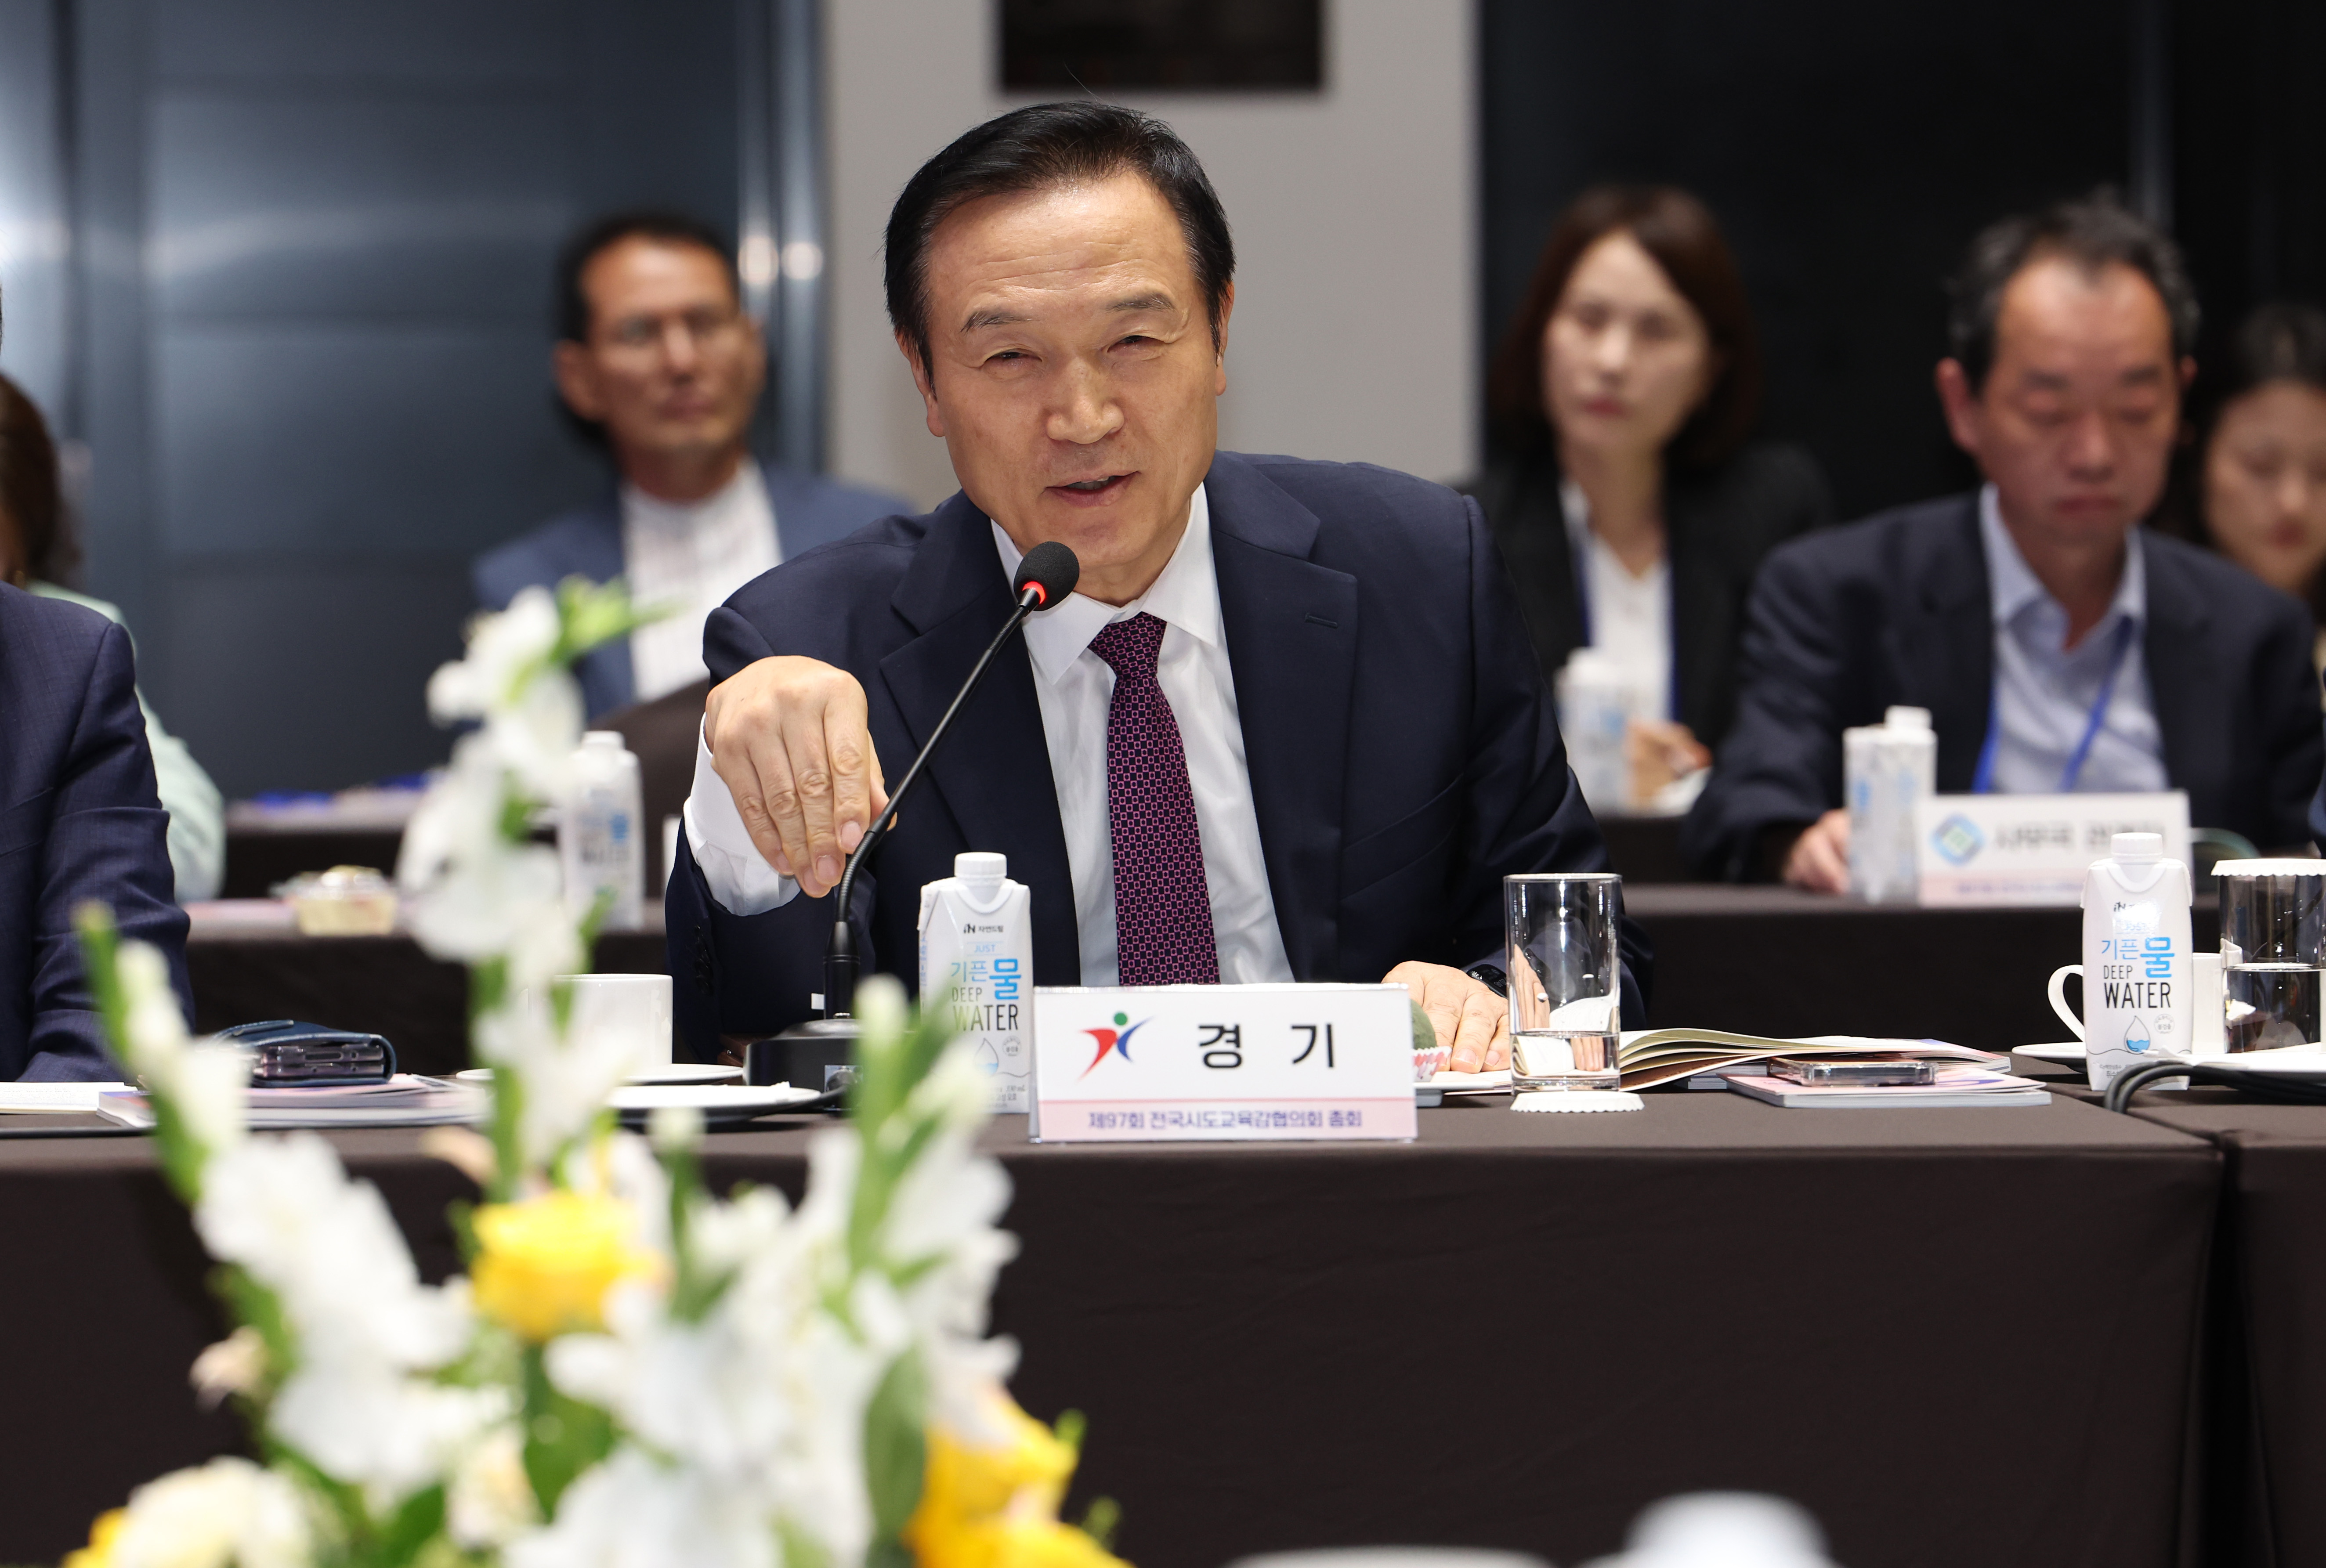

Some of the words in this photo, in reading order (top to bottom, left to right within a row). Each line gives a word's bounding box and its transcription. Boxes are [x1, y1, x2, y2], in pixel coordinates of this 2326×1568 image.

[974, 944, 995, 953] JUST
[2140, 937, 2175, 978] 물
[989, 958, 1021, 1000] 물
[2103, 965, 2133, 979] DEEP
[952, 987, 982, 1002] DEEP
[2104, 982, 2170, 1008] WATER
[953, 1004, 1018, 1031] WATER
[1089, 1111, 1144, 1129] 제97회
[1151, 1110, 1322, 1129] 전국시도교육감협의회
[1330, 1110, 1362, 1128] 총회
